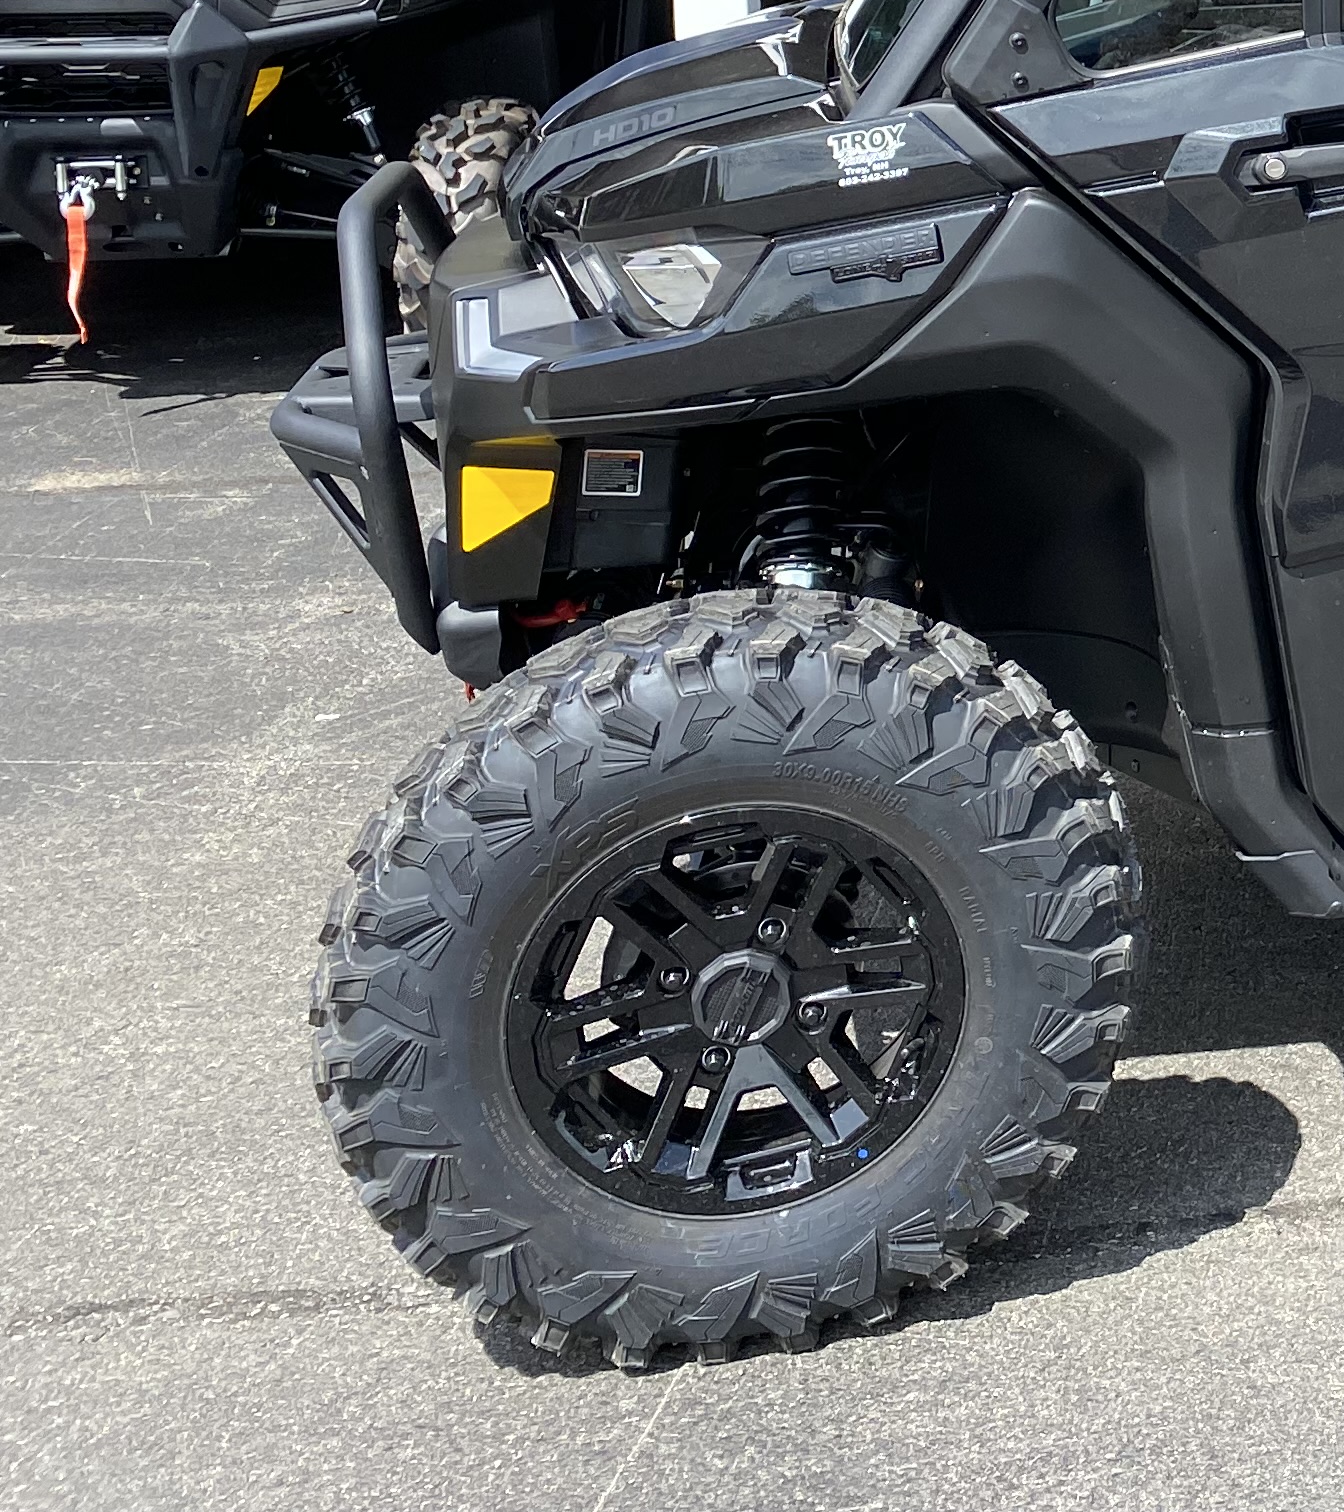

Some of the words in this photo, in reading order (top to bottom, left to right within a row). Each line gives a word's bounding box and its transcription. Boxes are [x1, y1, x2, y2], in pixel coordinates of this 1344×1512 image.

[592, 104, 678, 148] HD10
[827, 123, 907, 156] TROY
[789, 228, 936, 272] DEFENDER
